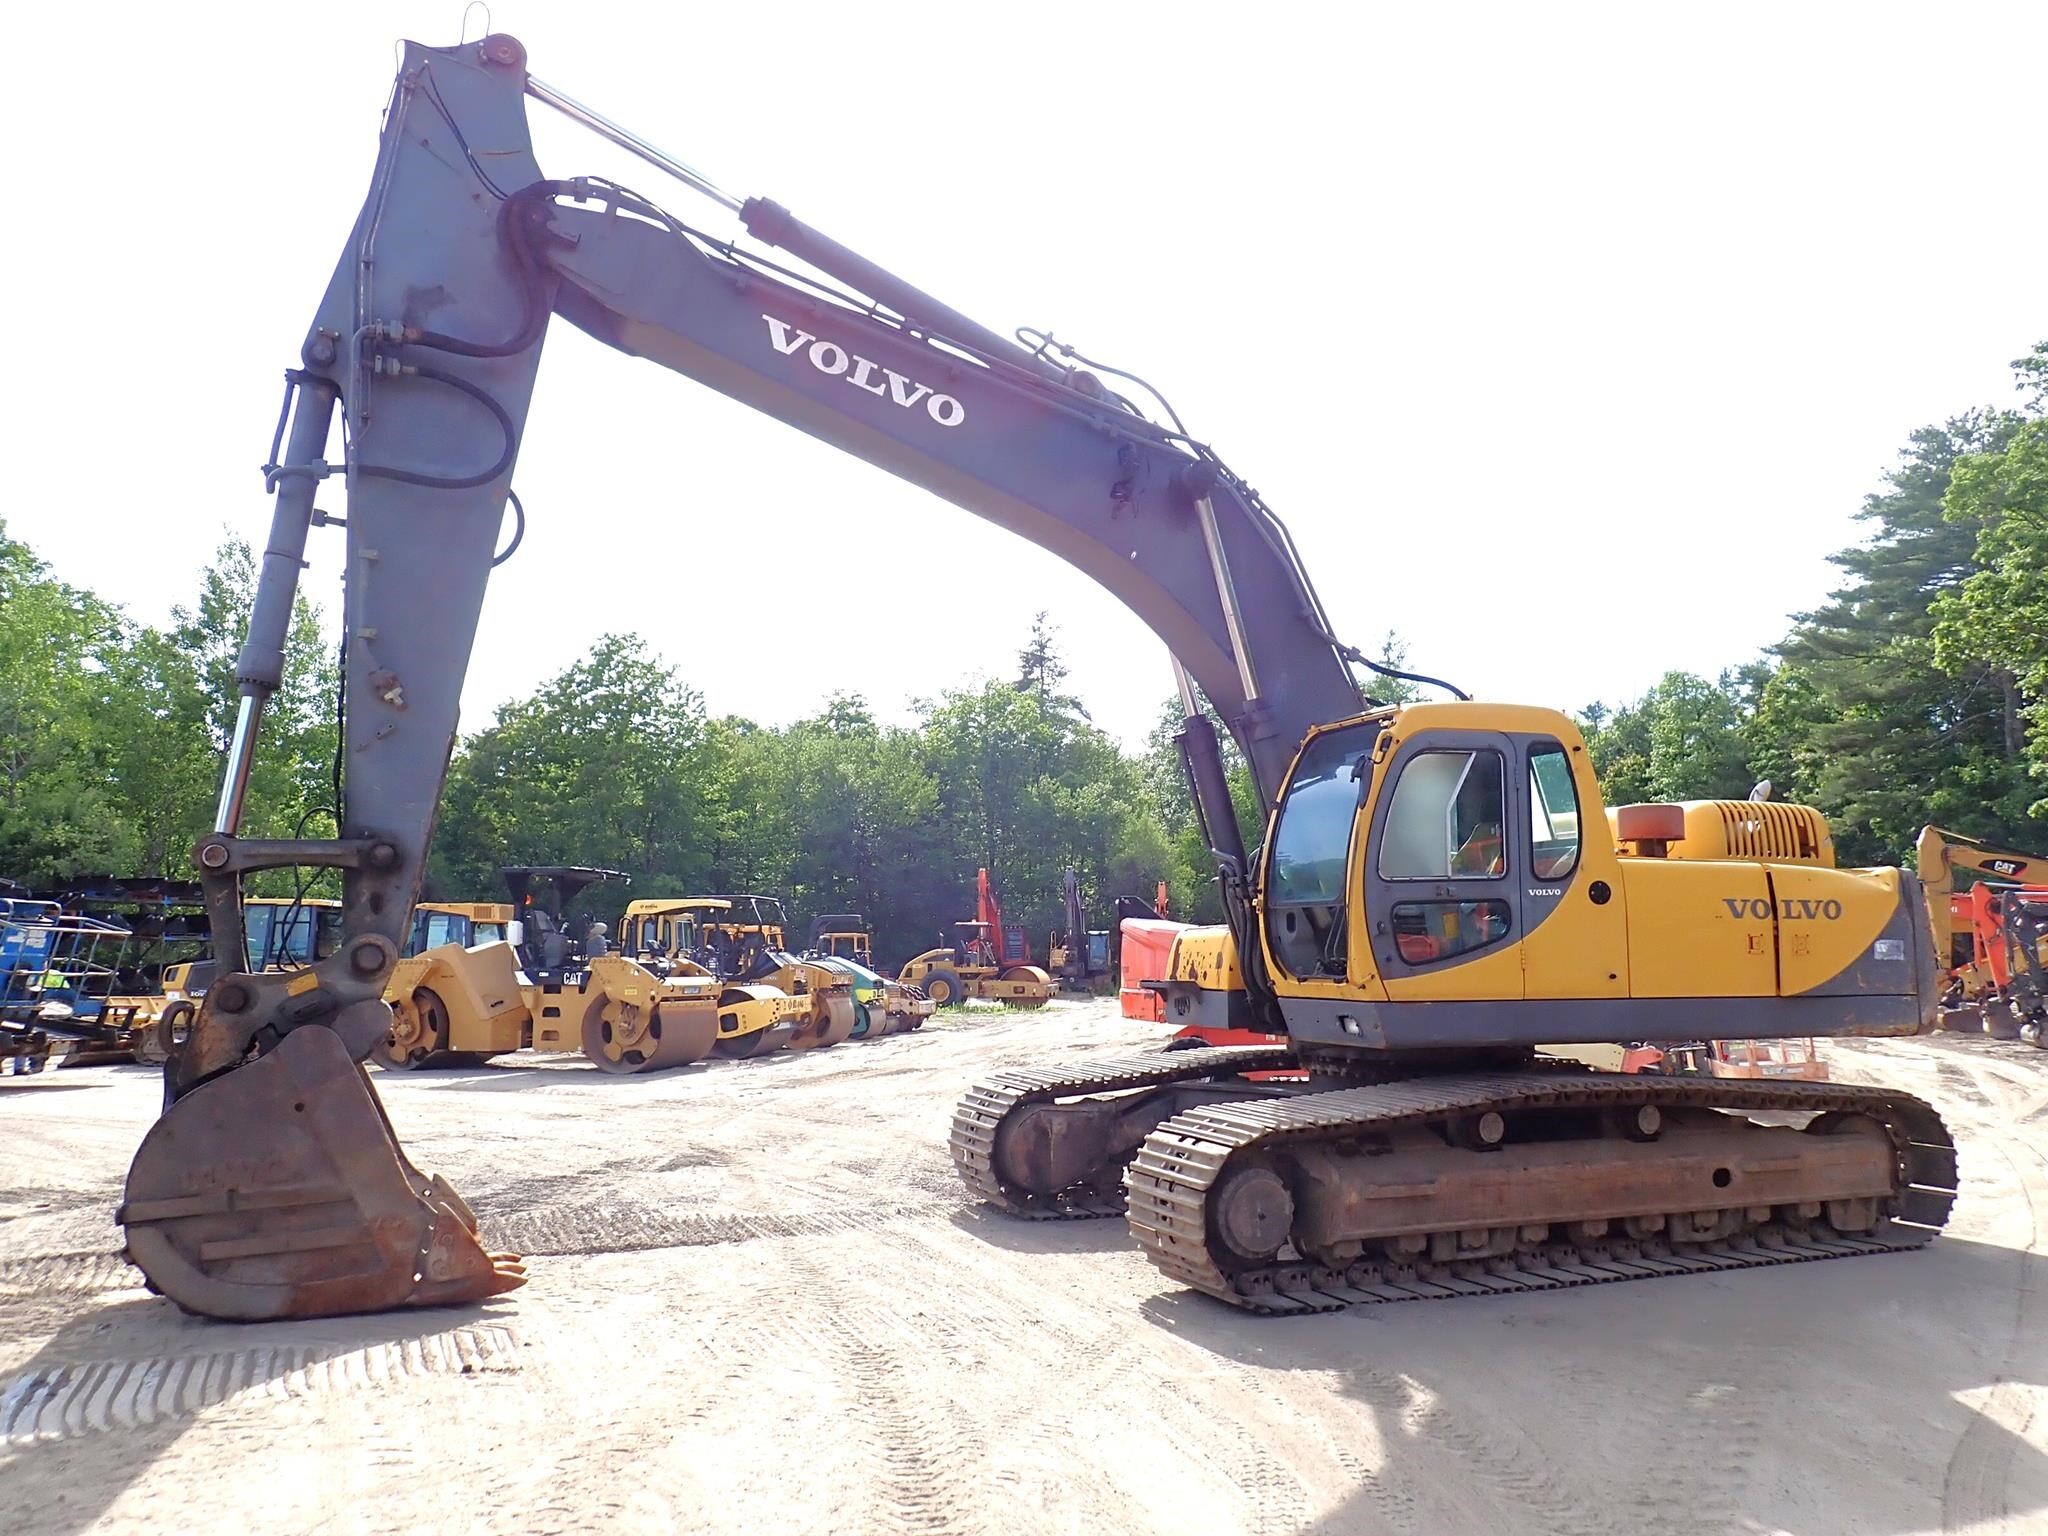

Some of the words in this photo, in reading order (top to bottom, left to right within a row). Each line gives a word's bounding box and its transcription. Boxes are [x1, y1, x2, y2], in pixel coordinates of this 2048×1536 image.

[762, 314, 965, 426] VOLVO
[1994, 861, 2016, 874] CAT
[1528, 888, 1561, 896] VOLVO
[1722, 898, 1842, 920] VOLVO
[563, 972, 583, 985] CAT
